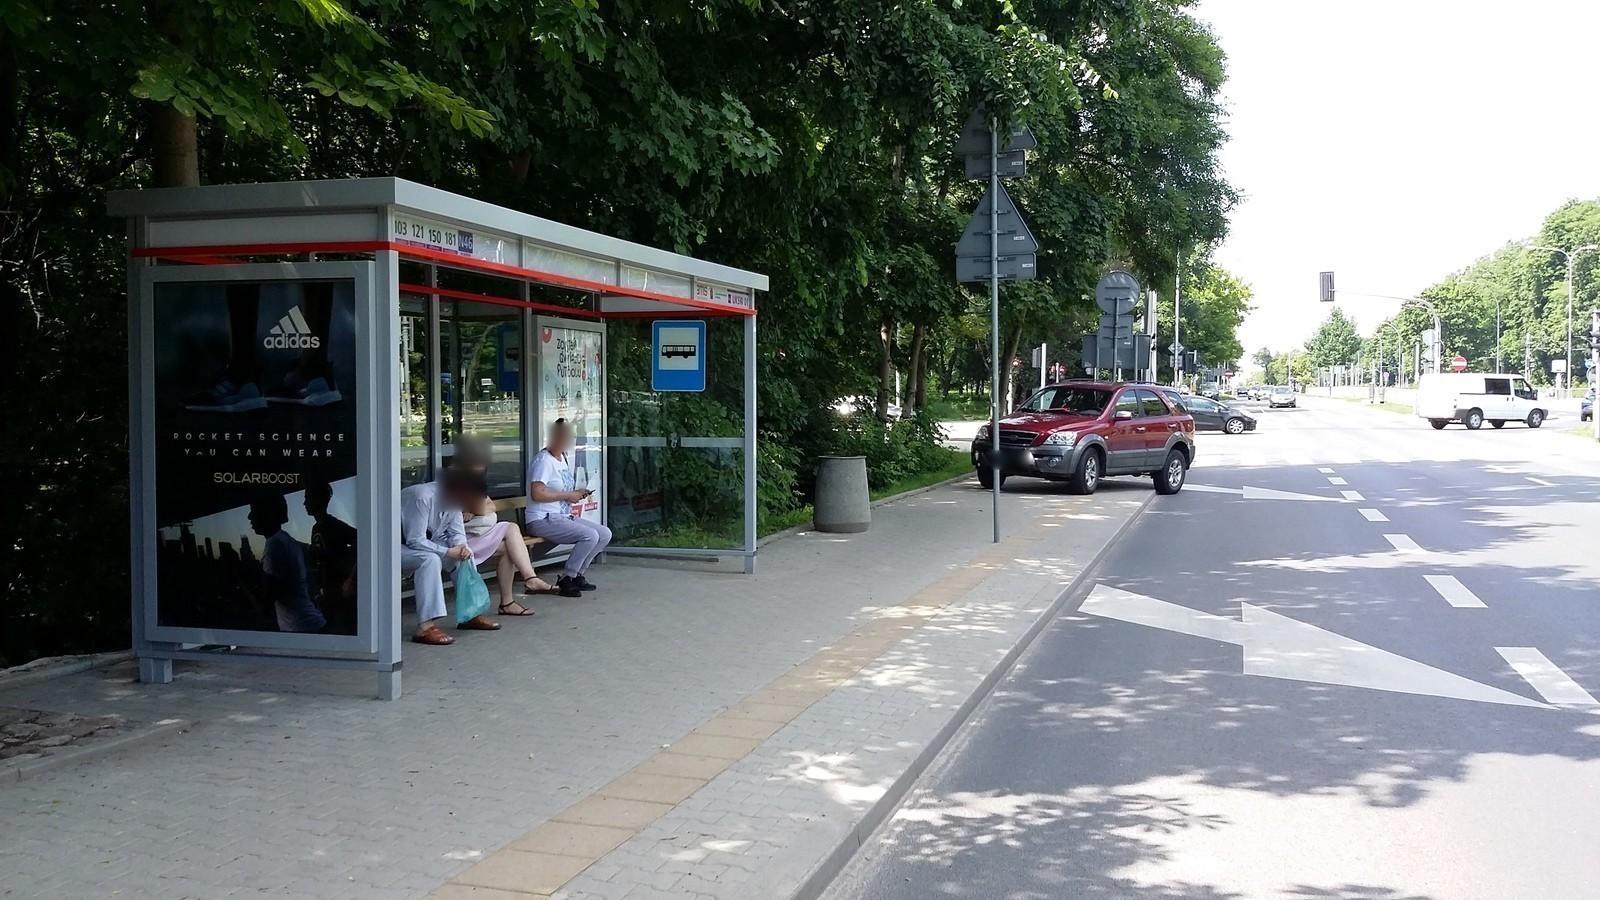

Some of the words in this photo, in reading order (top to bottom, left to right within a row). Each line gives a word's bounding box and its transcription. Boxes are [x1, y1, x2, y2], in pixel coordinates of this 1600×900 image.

[394, 220, 408, 236] 103
[411, 224, 424, 239] 121
[428, 229, 442, 244] 150
[444, 231, 457, 246] 181
[459, 234, 473, 250] N46
[263, 333, 320, 349] adidas
[173, 432, 243, 441] ROCKET
[259, 433, 345, 442] SCIENCE
[232, 448, 267, 457] CAN
[282, 449, 333, 458] WEAR
[213, 472, 300, 485] SOLARBOOST
